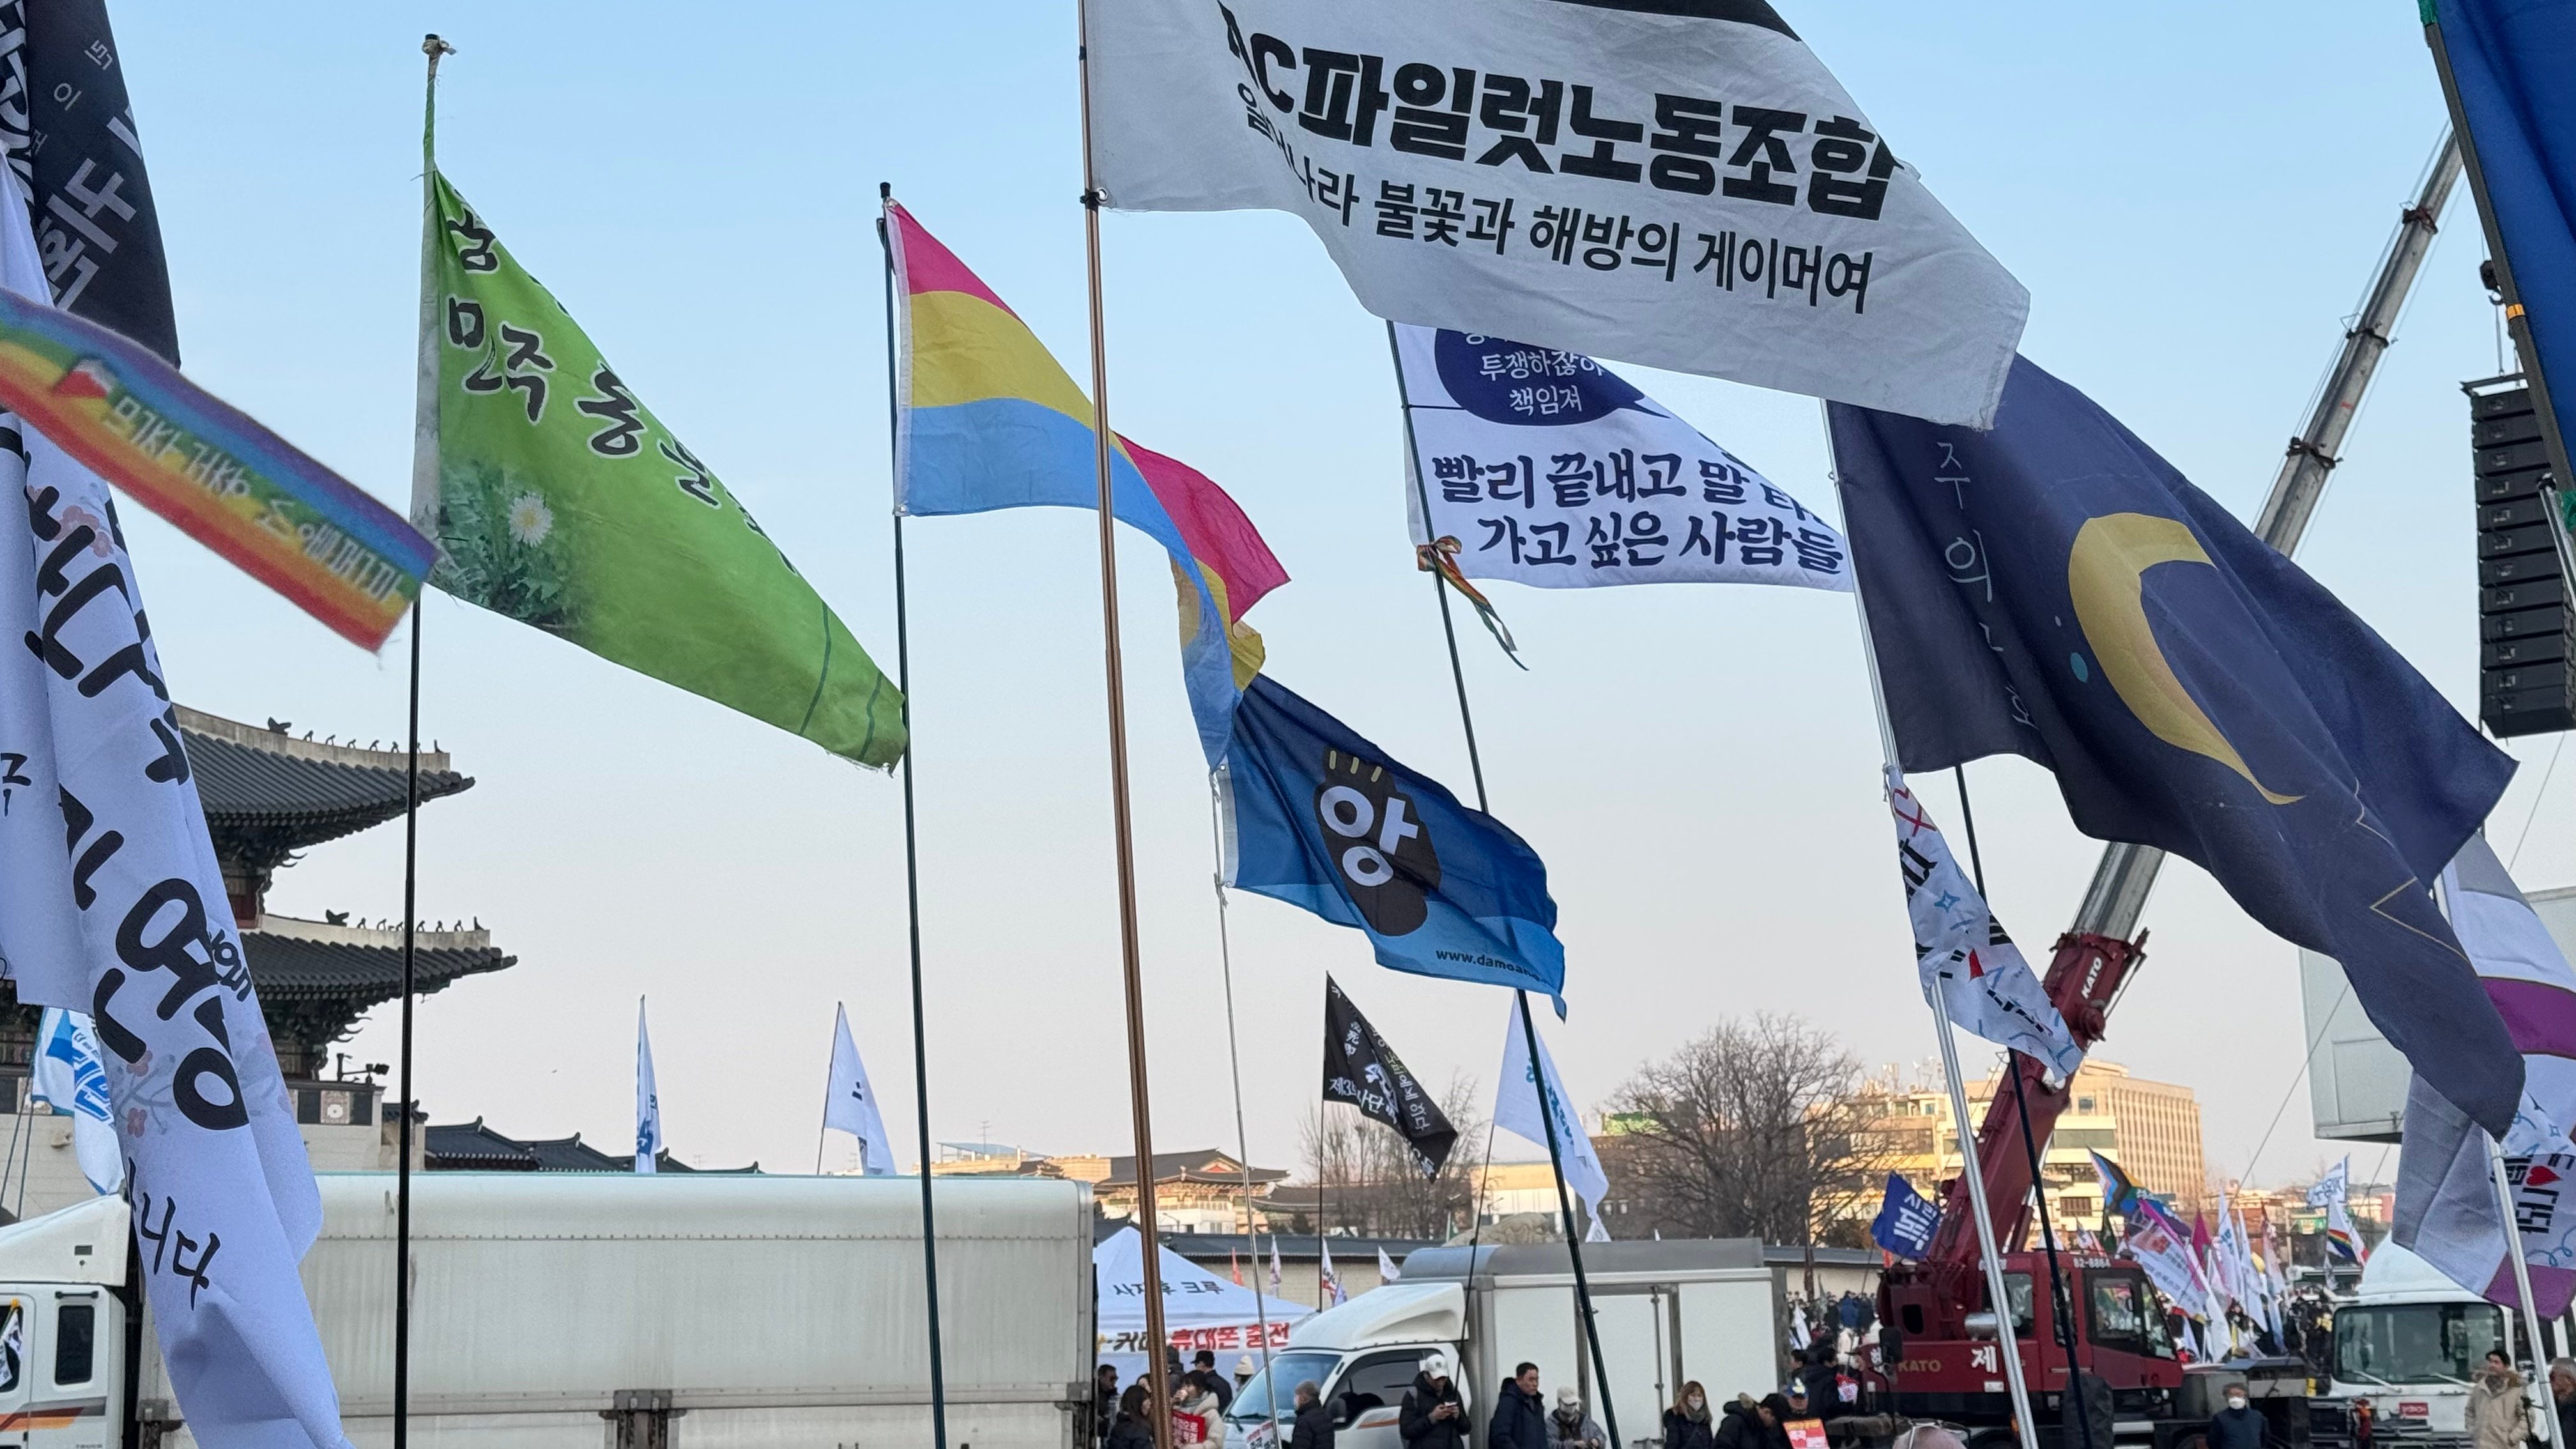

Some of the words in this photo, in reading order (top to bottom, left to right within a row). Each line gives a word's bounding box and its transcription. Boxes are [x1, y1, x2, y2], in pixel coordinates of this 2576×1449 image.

[1374, 180, 1515, 255] 불꽃과
[1529, 205, 1680, 283] 해방의
[1693, 231, 1873, 316] 게이머여
[1509, 385, 1583, 417] 책임져
[1432, 454, 1535, 509] 빨리
[1546, 448, 1688, 508] 끝내고
[1698, 458, 1749, 505] 말
[1477, 515, 1577, 566] 가고
[1584, 510, 1669, 569] 싶은
[1679, 511, 1844, 575] 사람들
[1320, 786, 1419, 887] 앙
[2080, 956, 2103, 1000] KATO
[1170, 1326, 1241, 1351] 휴대폰
[1245, 1322, 1291, 1348] 충전
[1897, 1359, 1942, 1373] KATO
[1971, 1345, 1998, 1374] 제
